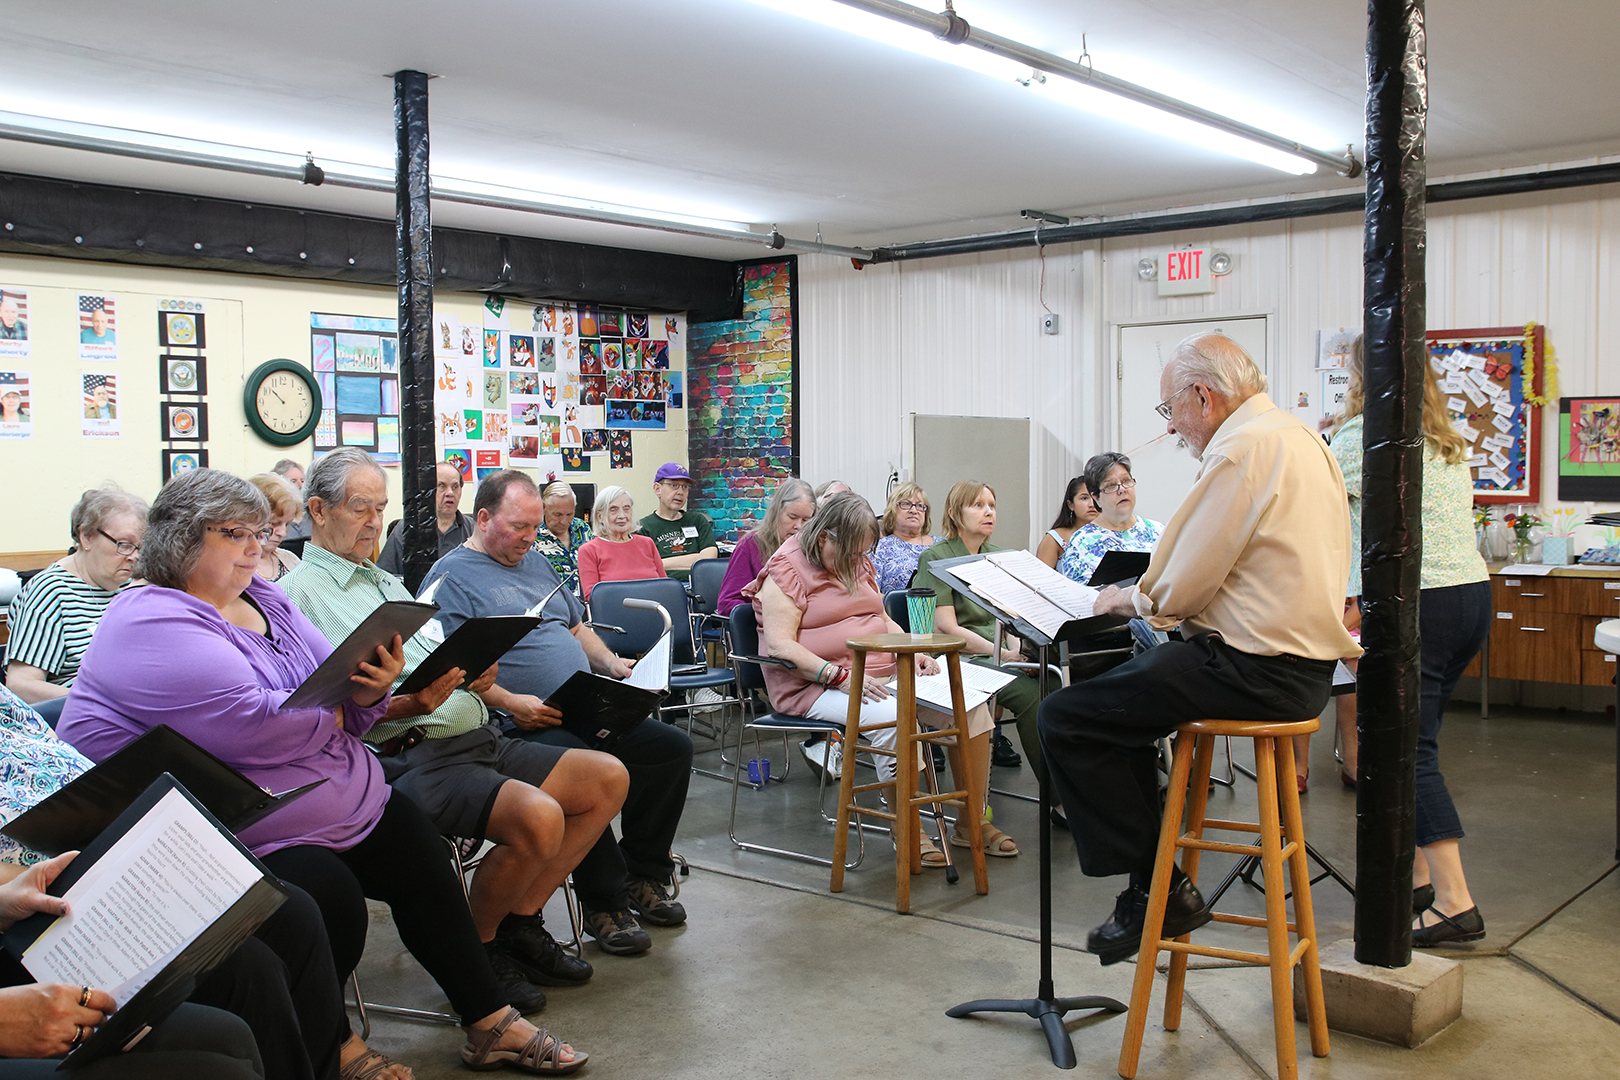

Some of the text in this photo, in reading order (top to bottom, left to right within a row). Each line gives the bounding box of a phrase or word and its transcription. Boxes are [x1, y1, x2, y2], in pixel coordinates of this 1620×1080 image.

[1168, 251, 1203, 281] EXIT
[610, 408, 664, 418] FOX CAVE
